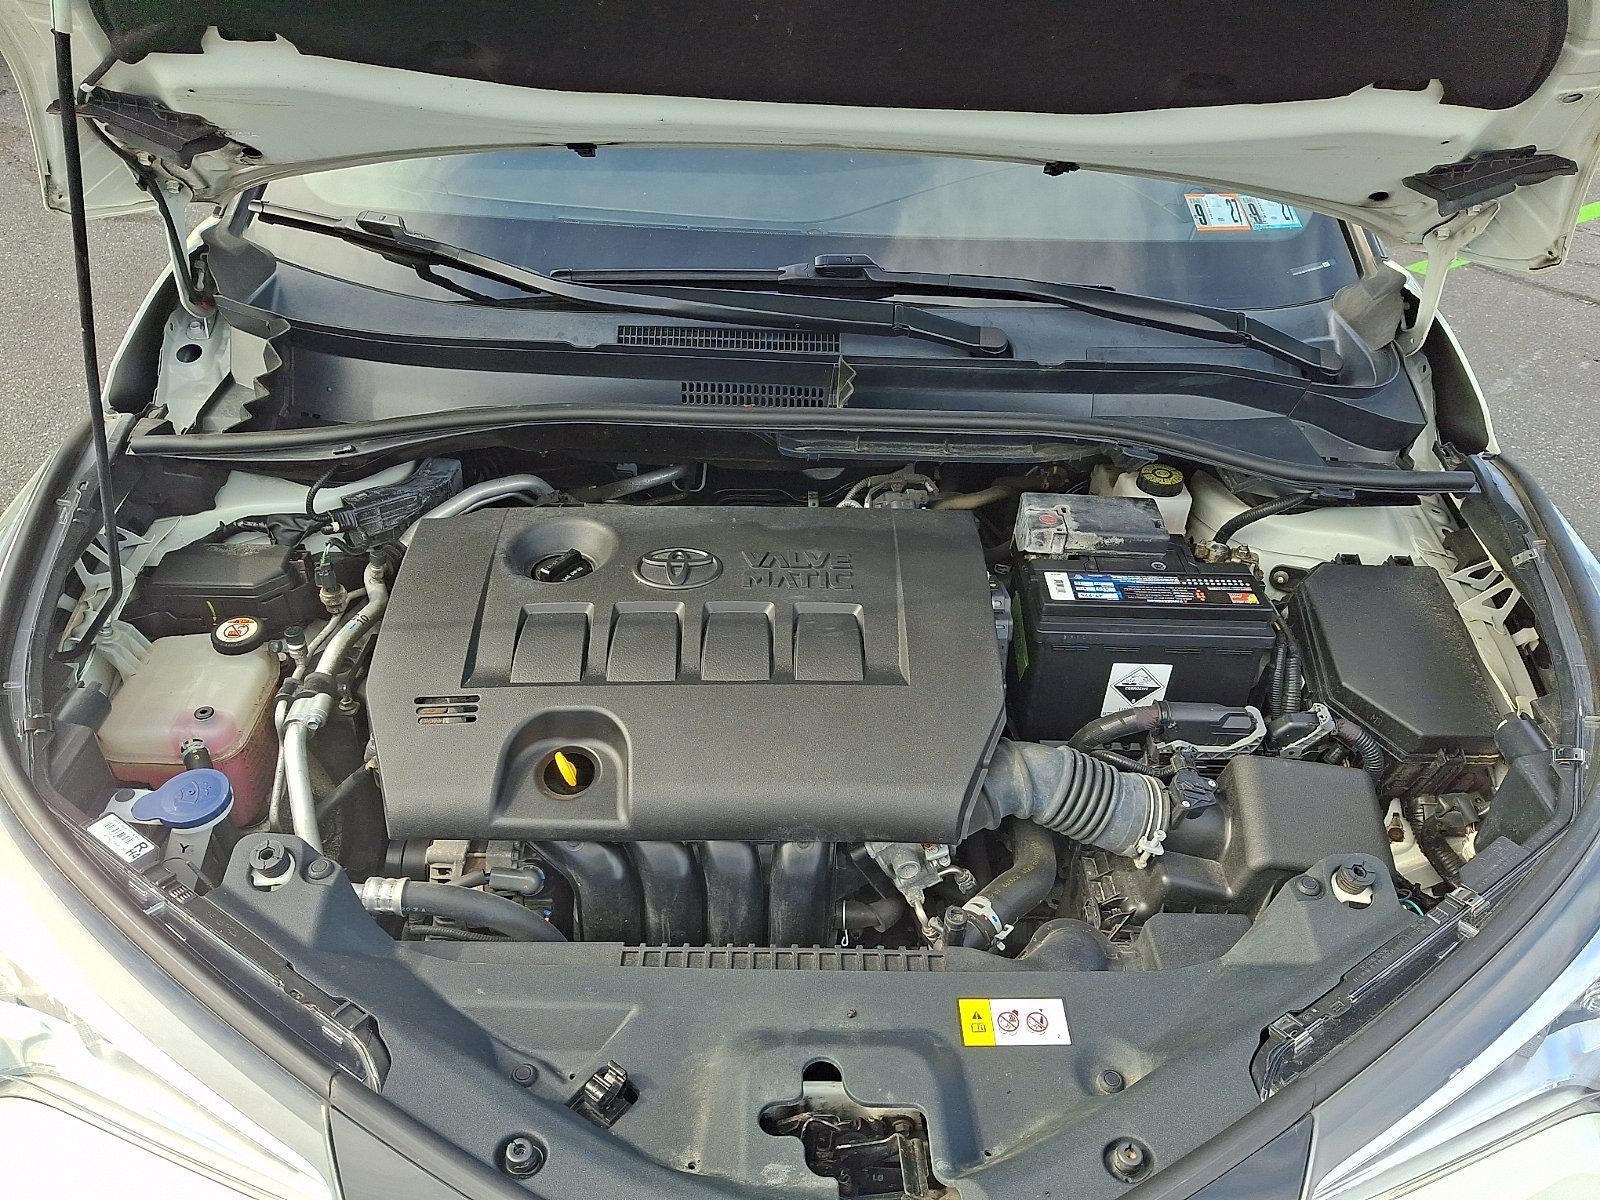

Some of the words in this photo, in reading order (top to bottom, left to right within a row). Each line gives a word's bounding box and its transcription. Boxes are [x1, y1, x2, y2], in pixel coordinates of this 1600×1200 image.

[741, 550, 853, 569] VALVE
[742, 570, 854, 589] MATIC
[133, 841, 148, 853] R
[179, 842, 190, 854] Y
